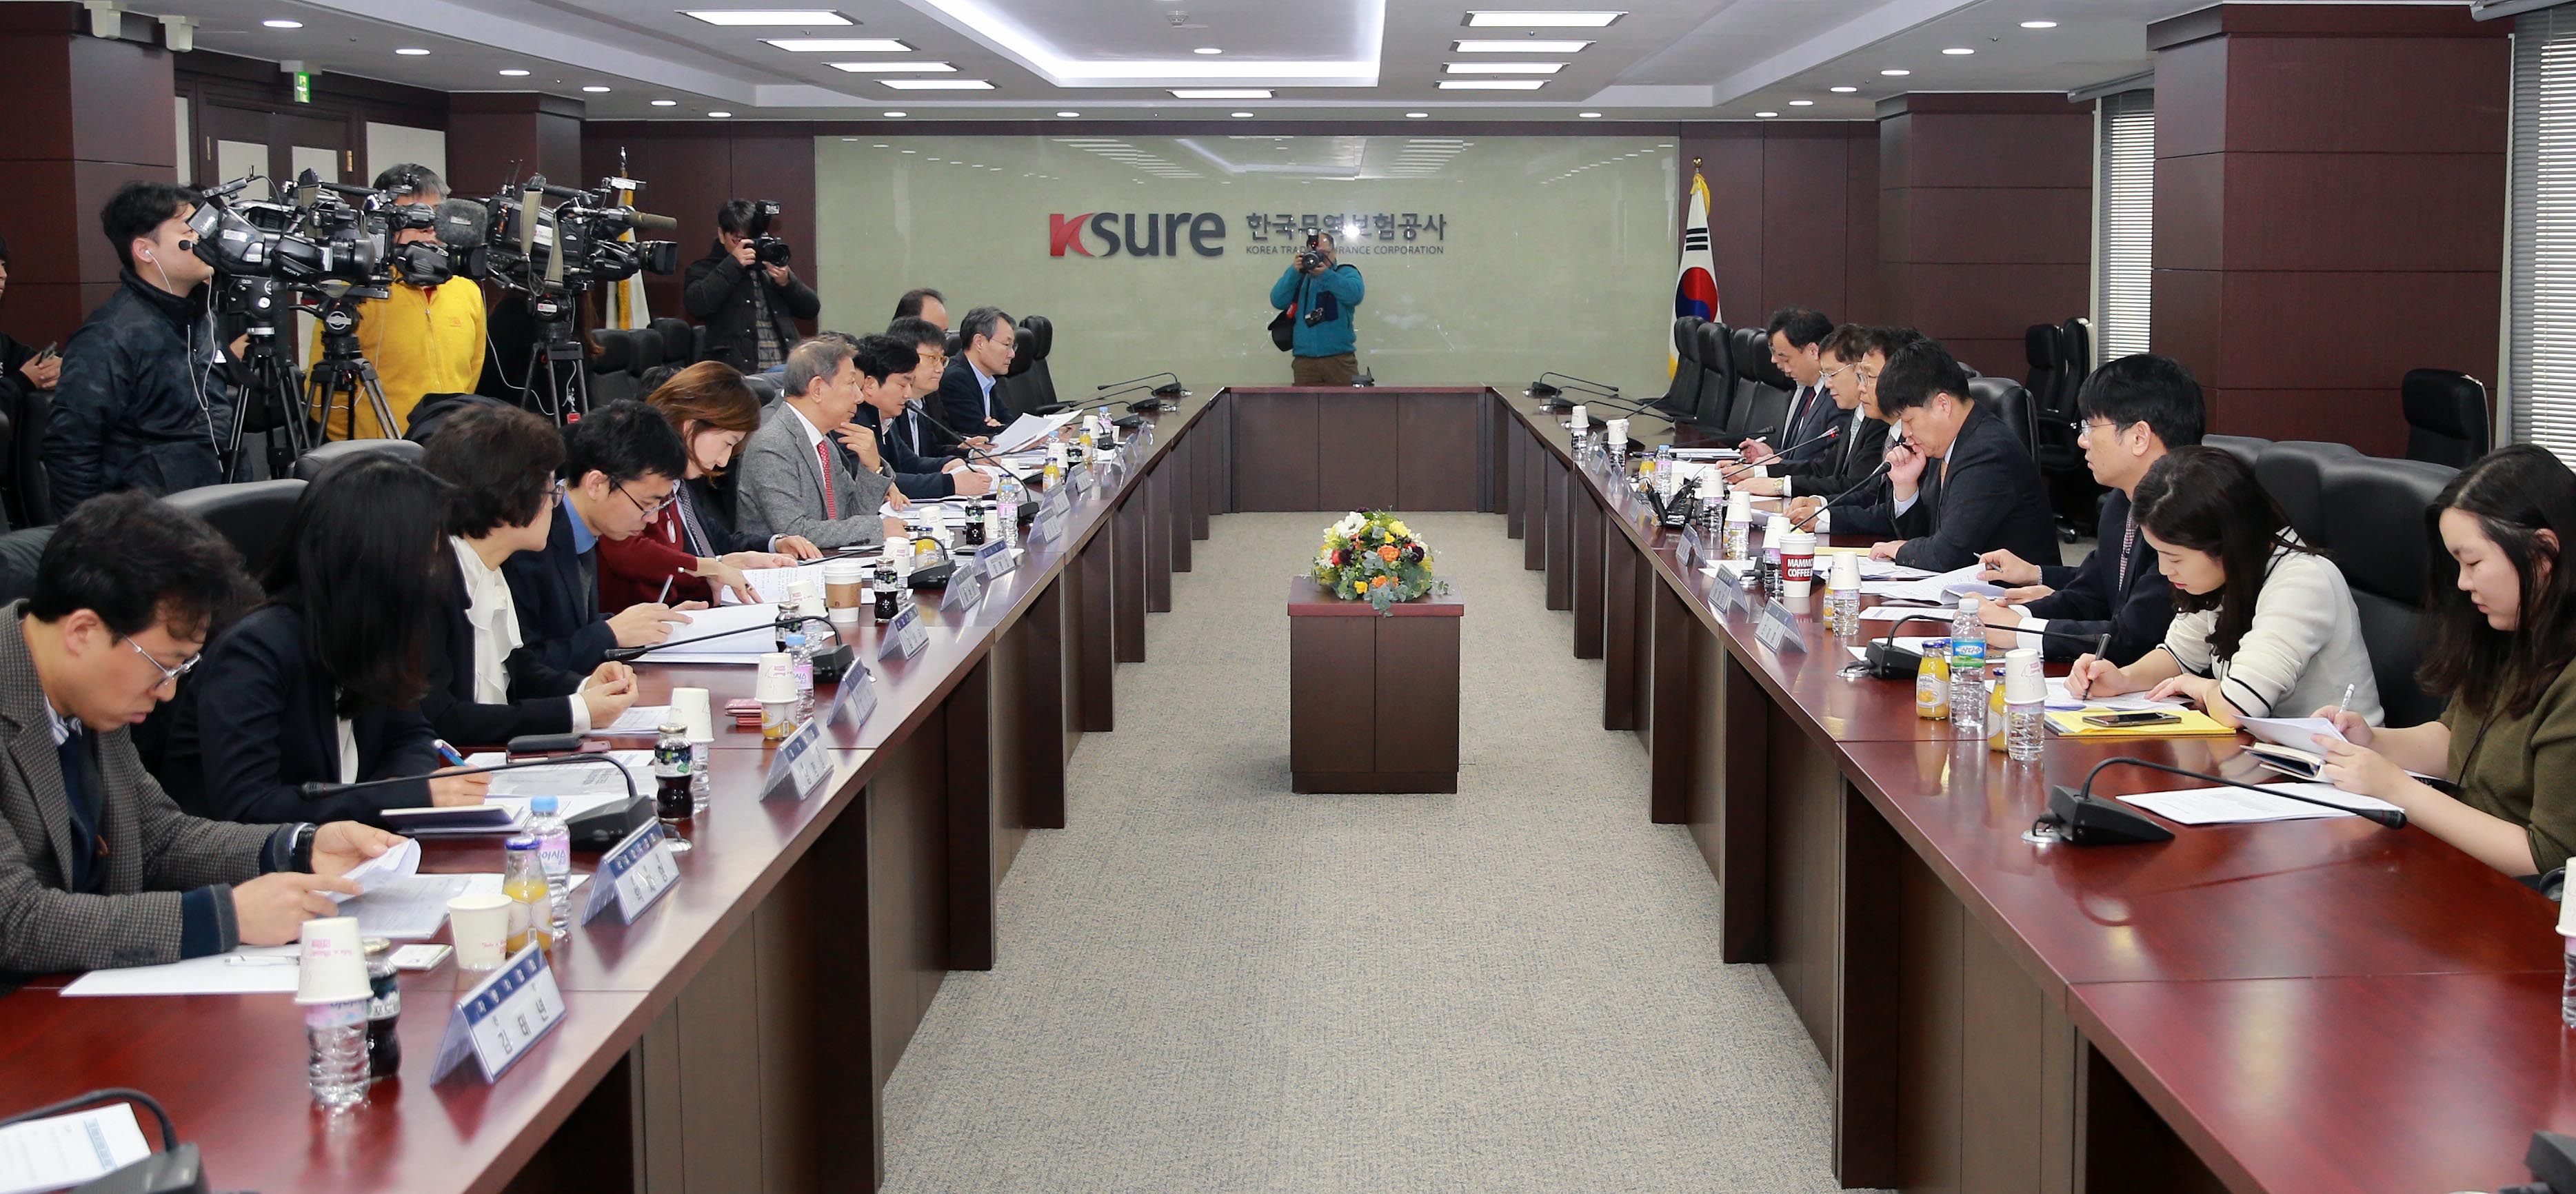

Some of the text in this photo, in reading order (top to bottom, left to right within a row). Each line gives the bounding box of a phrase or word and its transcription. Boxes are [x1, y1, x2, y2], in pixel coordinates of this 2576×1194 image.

[1246, 245, 1277, 255] KOREA
[1281, 245, 1309, 255] TRAD
[1374, 245, 1445, 255] CORPORATION
[1787, 568, 1811, 578] COFFEE
